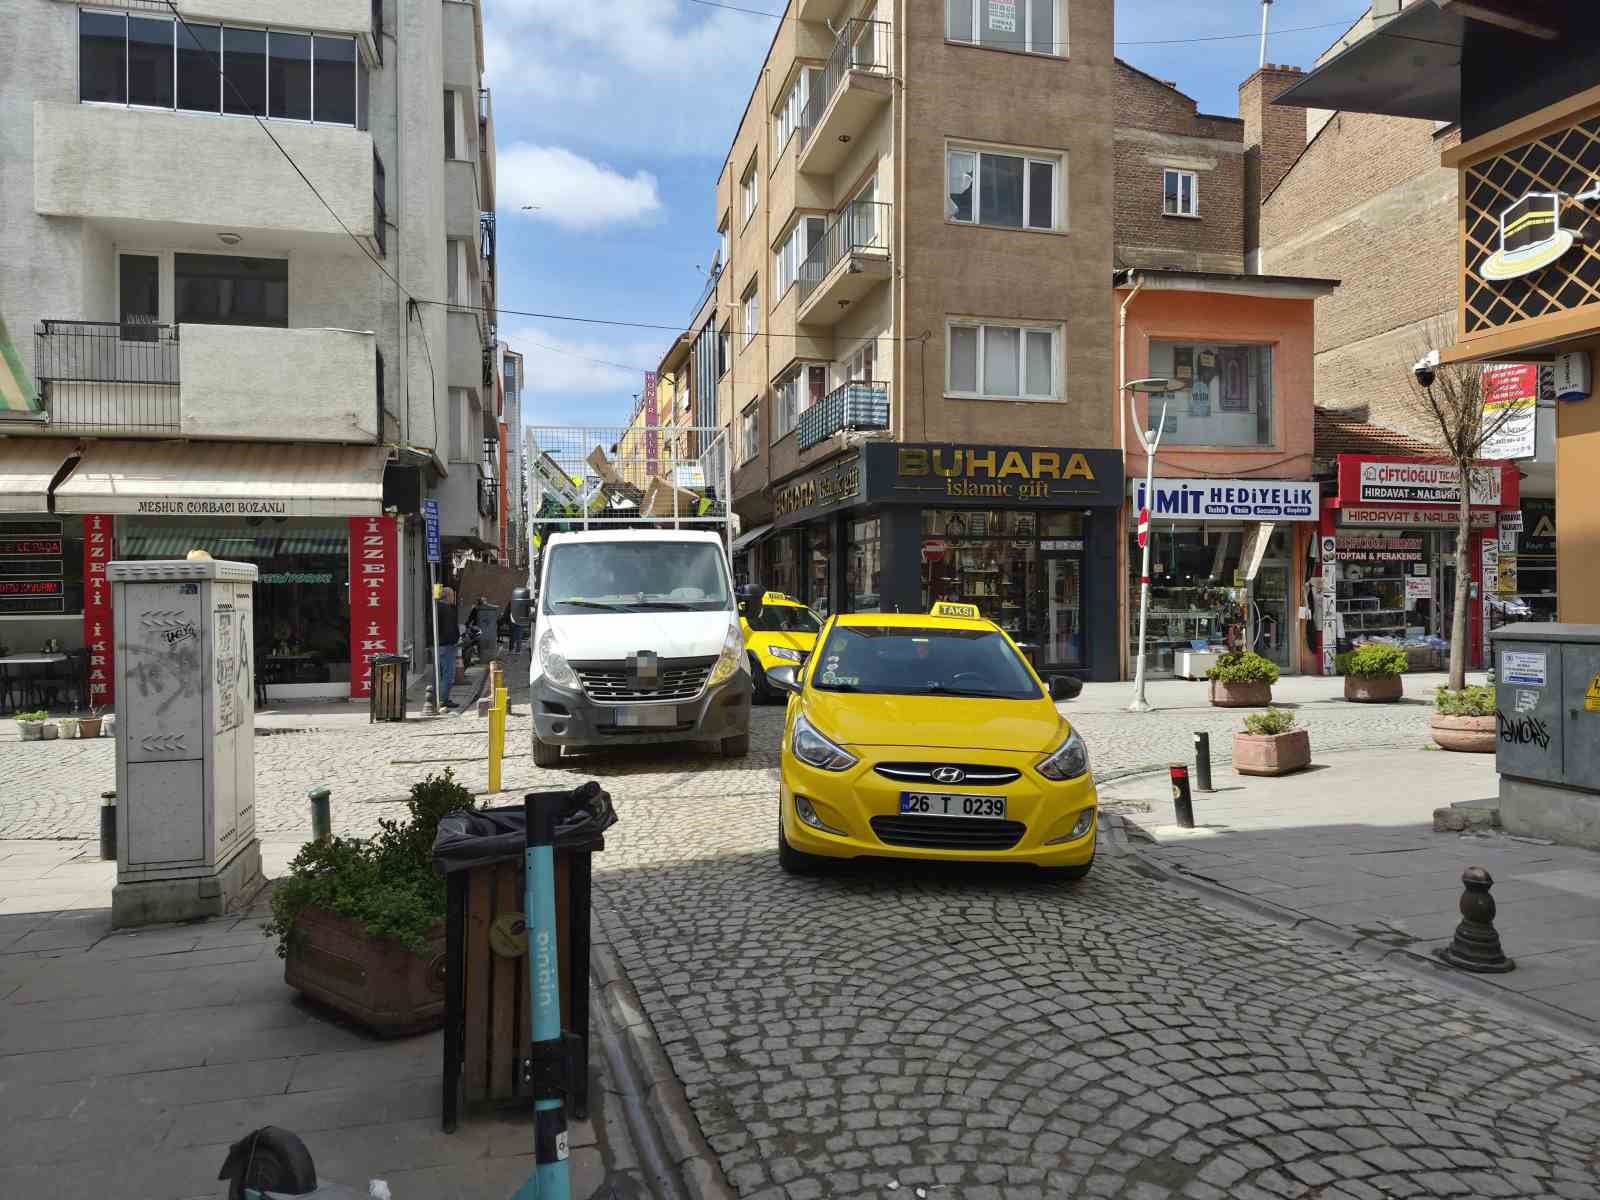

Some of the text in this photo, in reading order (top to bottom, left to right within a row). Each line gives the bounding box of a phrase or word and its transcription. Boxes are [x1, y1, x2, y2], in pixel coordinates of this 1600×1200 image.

[898, 448, 1095, 480] BUHARA
[946, 478, 1049, 501] islamic gift
[1365, 487, 1409, 498] HIRDAVAT
[238, 502, 285, 513] BOZANLI
[1348, 511, 1408, 521] HIRDAVAT
[1413, 512, 1421, 522] &
[1336, 552, 1366, 560] TOPTAN
[1377, 552, 1422, 560] PERAKENDE
[910, 795, 930, 812] 26
[941, 797, 951, 813] T
[963, 798, 1004, 816] 0239
